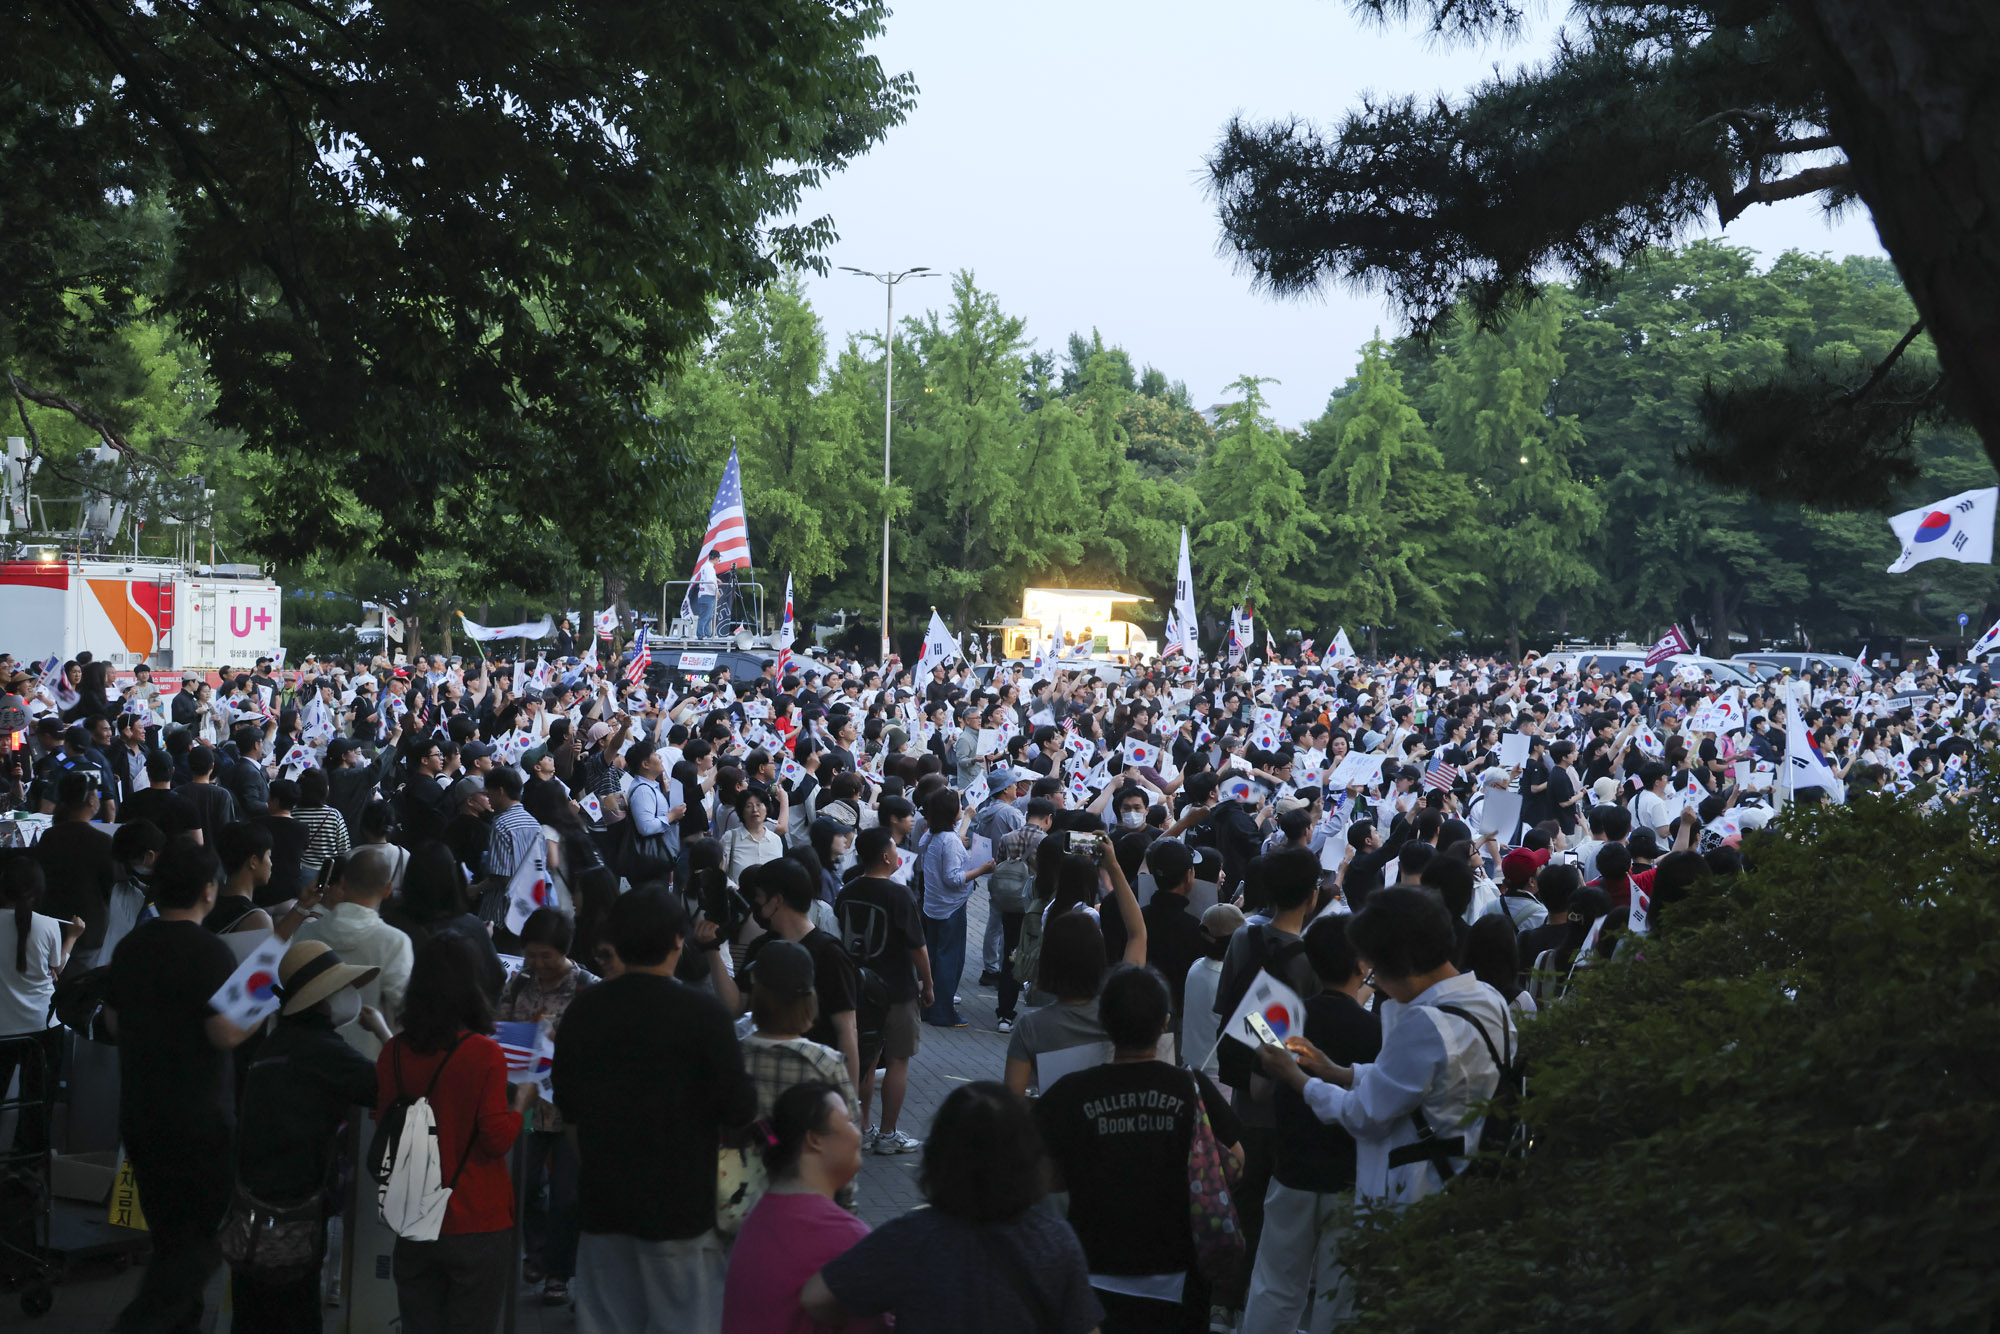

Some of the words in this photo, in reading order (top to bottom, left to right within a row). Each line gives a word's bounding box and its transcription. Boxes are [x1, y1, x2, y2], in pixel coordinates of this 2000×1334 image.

[230, 606, 272, 637] U+
[229, 649, 247, 658] 일상을
[1097, 1116, 1135, 1135] BOOK
[1138, 1113, 1175, 1131] CLUB
